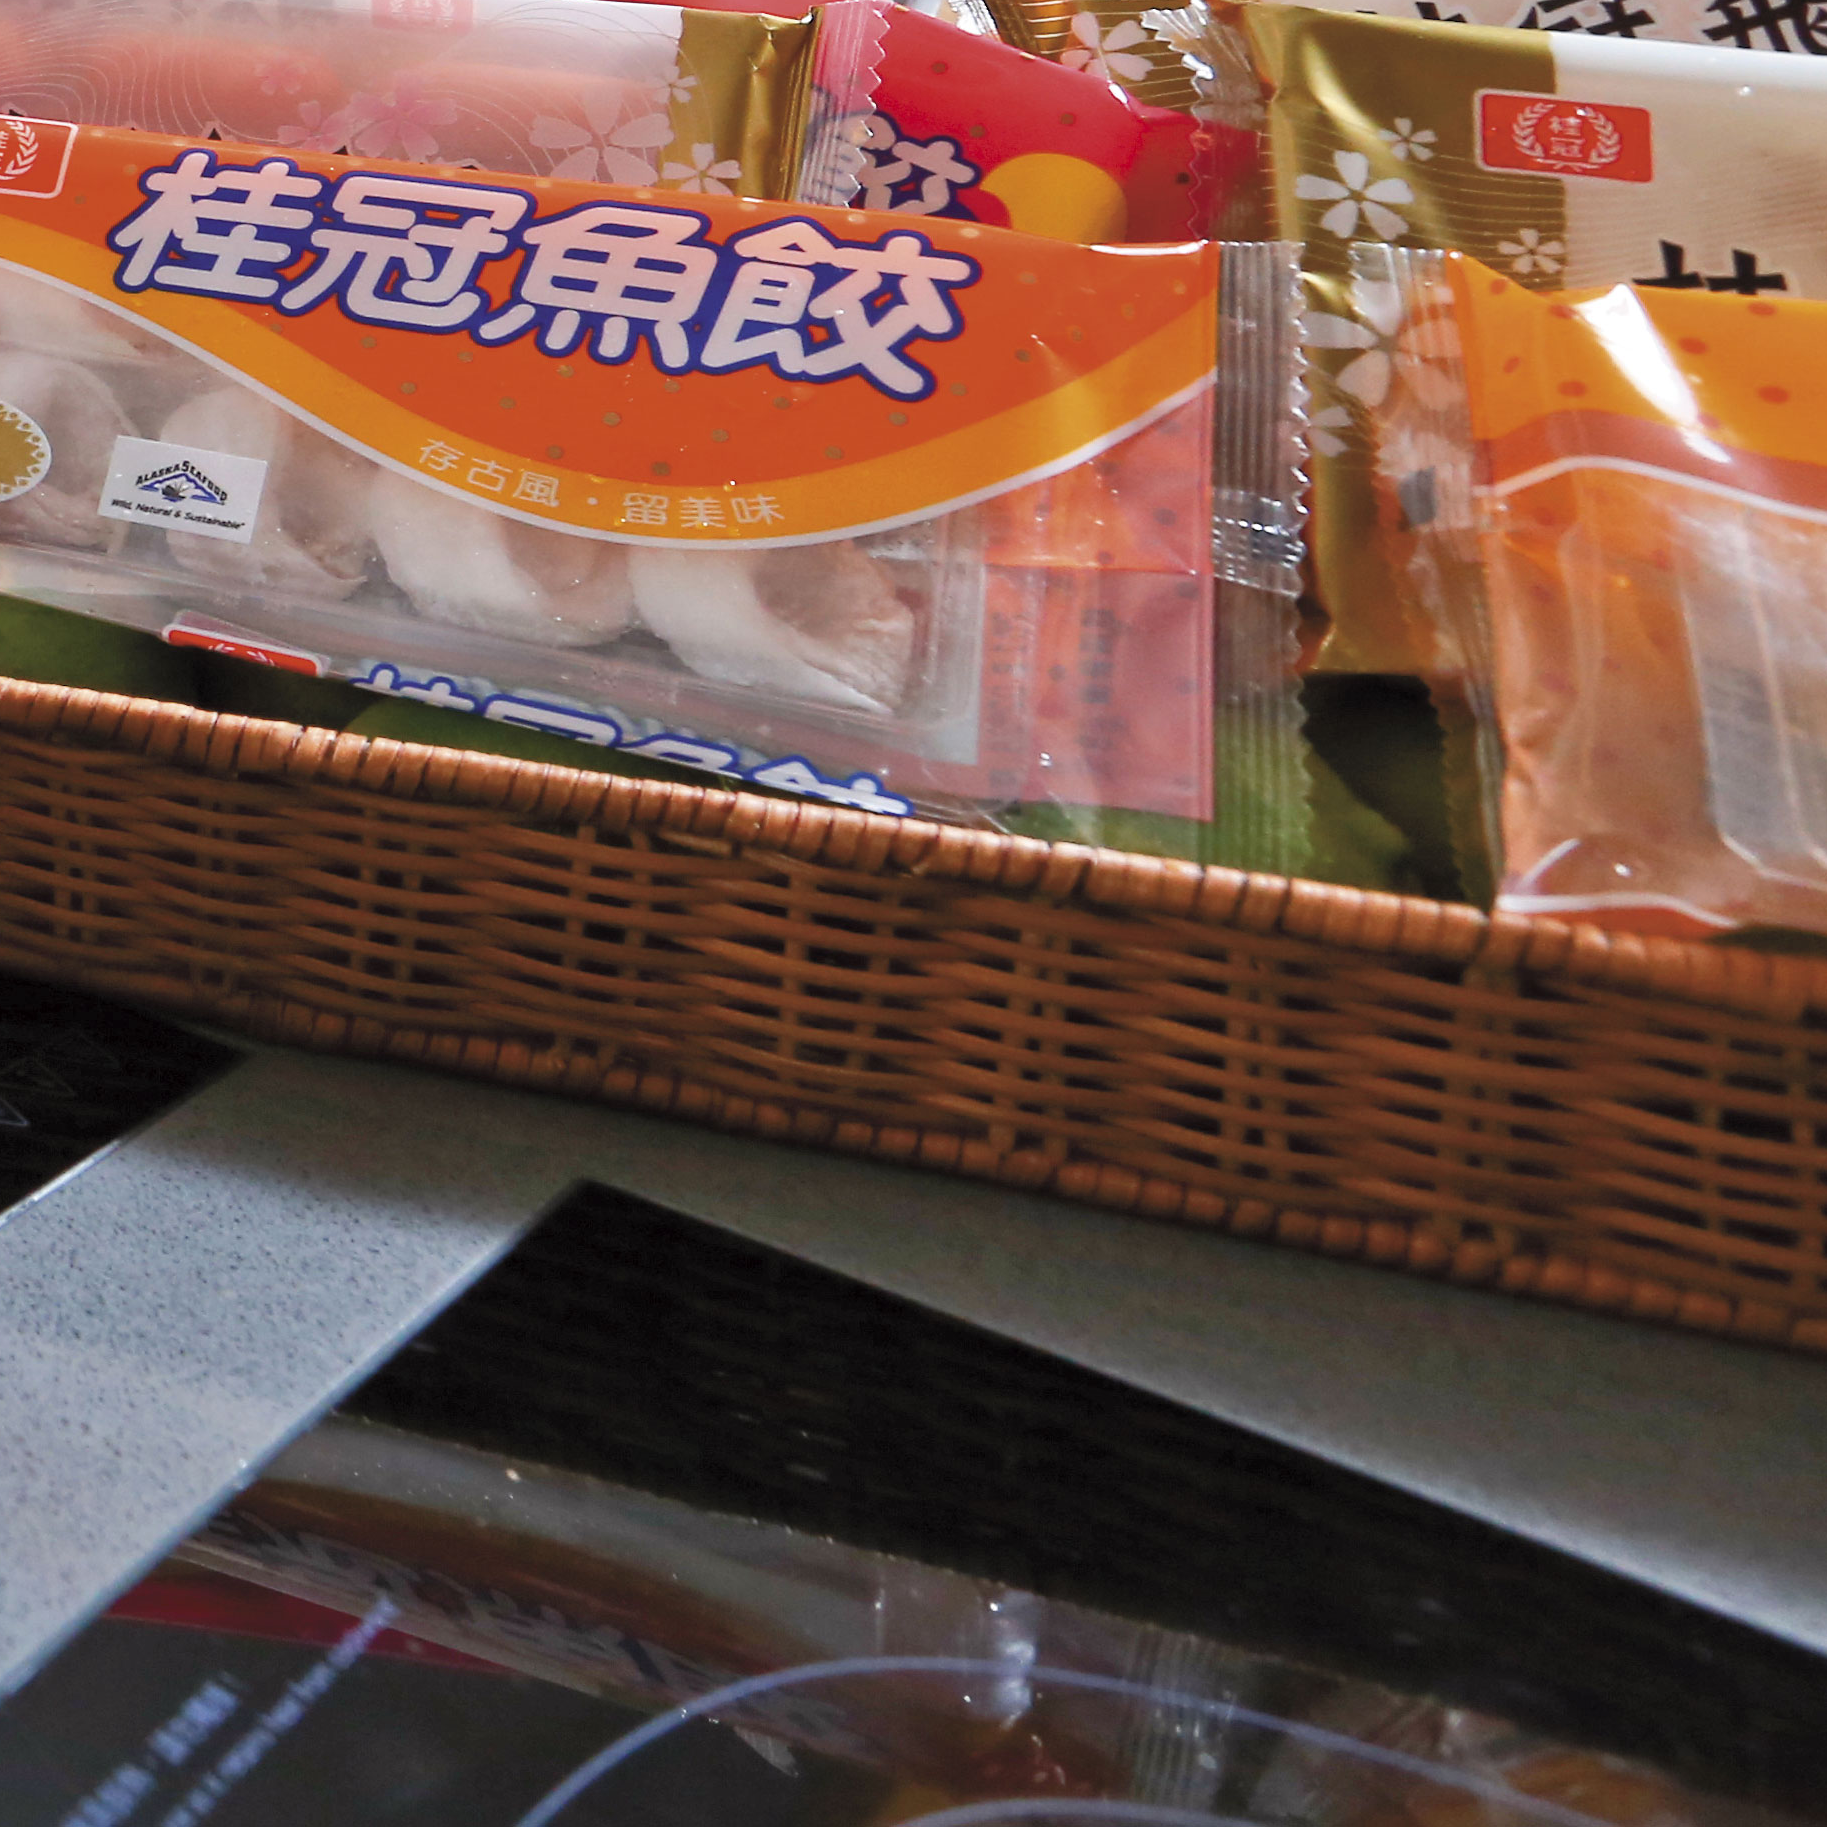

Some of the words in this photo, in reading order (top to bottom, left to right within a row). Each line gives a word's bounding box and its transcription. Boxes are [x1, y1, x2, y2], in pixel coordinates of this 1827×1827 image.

[108, 147, 977, 397] 桂冠魚餃
[135, 462, 181, 486] ALASKA
[136, 503, 173, 518] Natural
